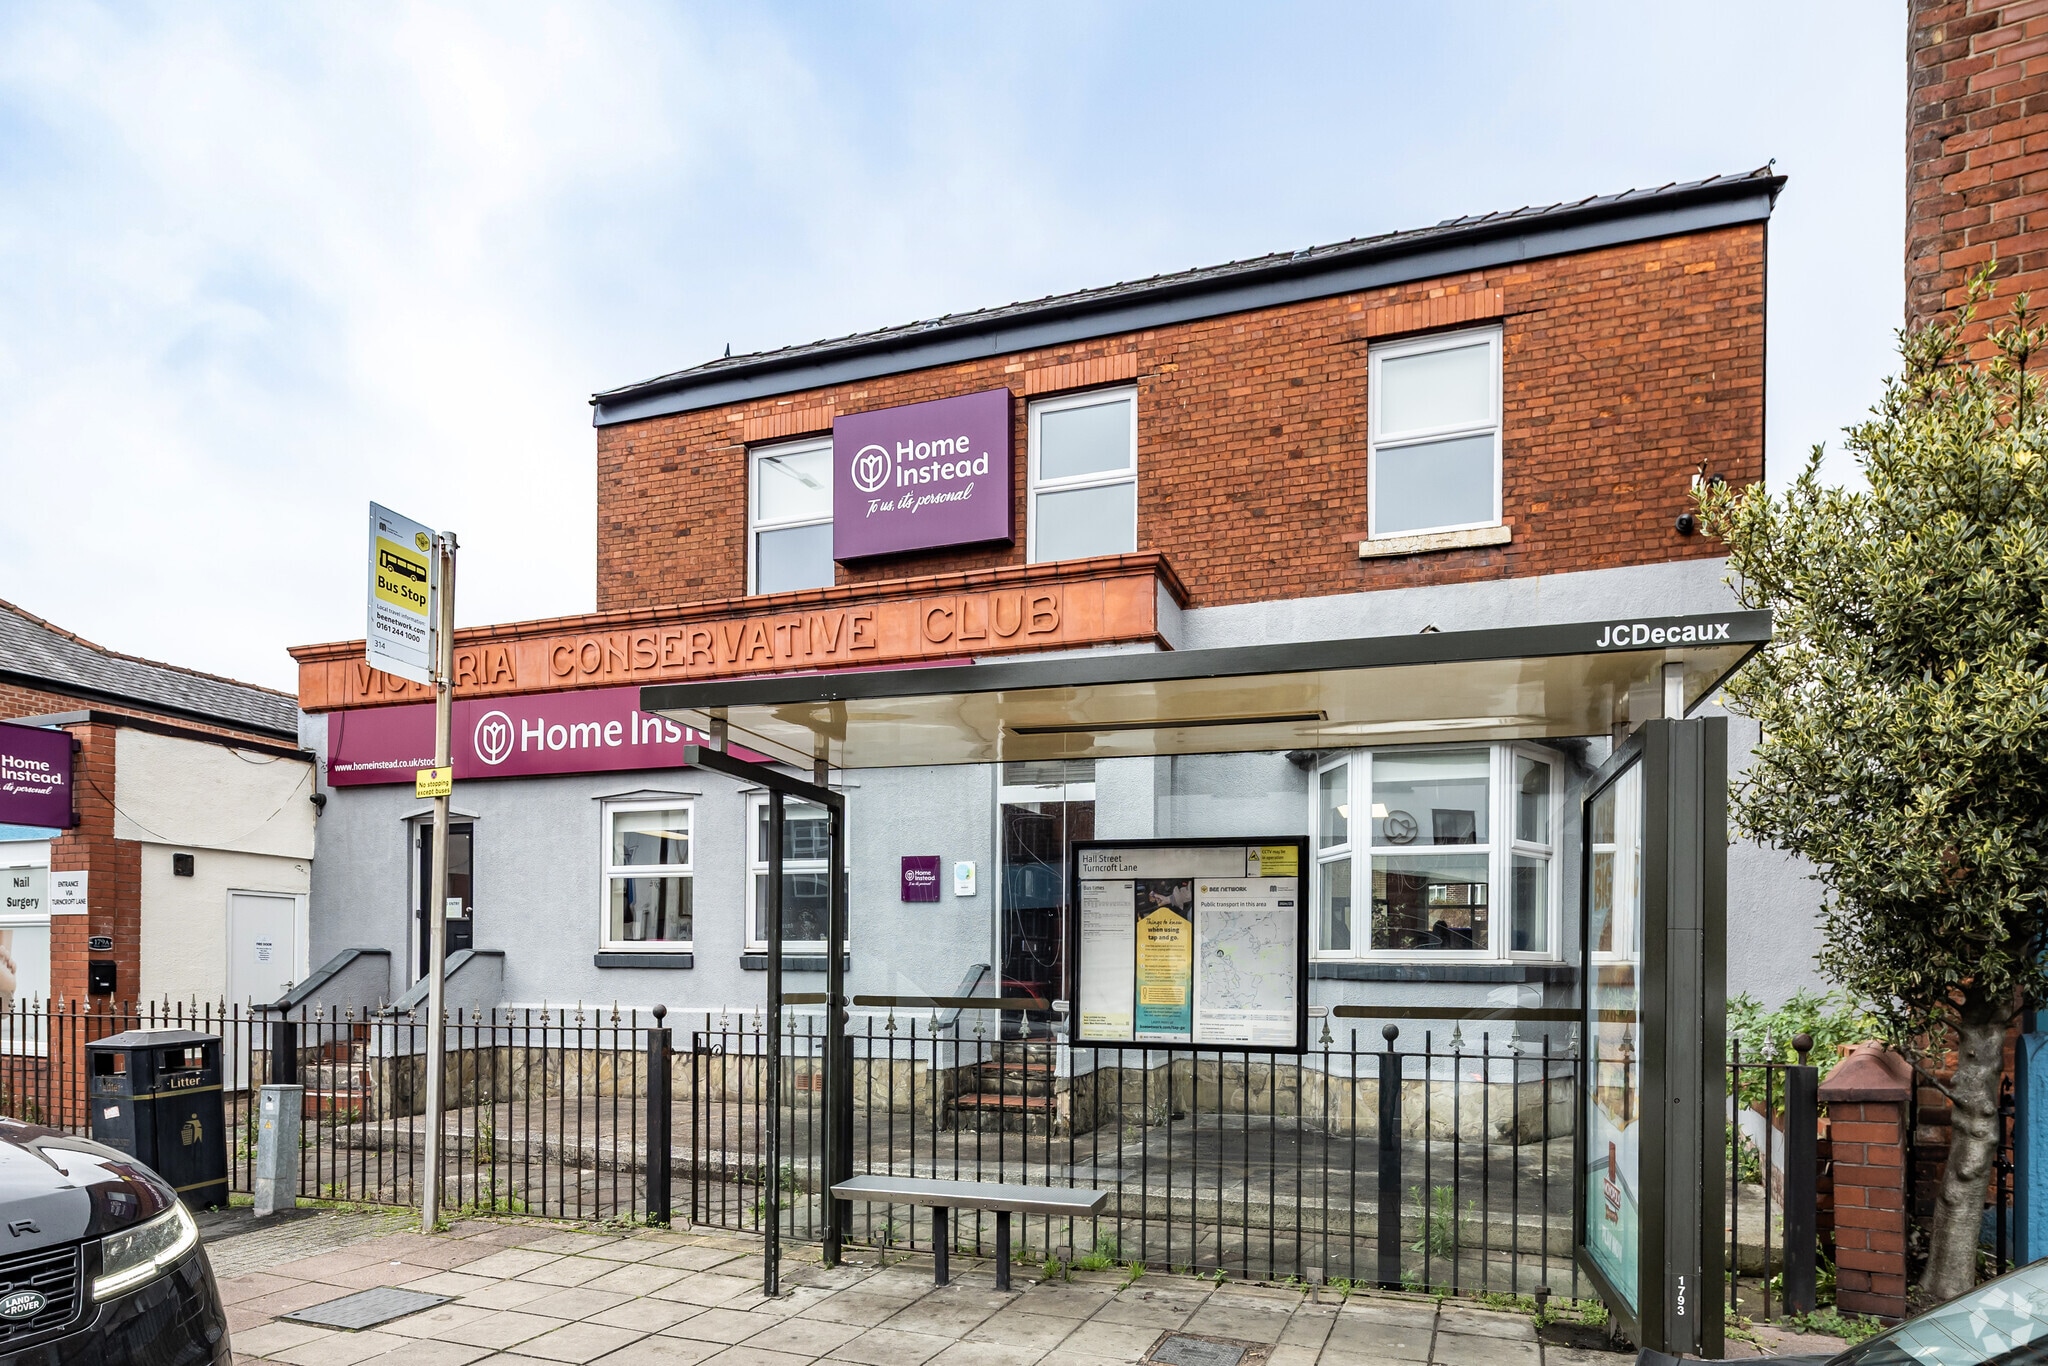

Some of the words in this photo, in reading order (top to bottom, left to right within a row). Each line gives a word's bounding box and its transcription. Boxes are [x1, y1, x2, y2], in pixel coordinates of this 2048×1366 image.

[896, 436, 970, 463] Home
[896, 452, 989, 487] Instead
[866, 499, 881, 518] To
[880, 500, 895, 511] us,
[912, 482, 974, 513] personal
[378, 575, 398, 594] Bus
[401, 585, 426, 607] Stop
[377, 604, 388, 612] Local
[389, 608, 400, 617] travel
[401, 614, 426, 626] information:
[377, 612, 426, 636] beenetwork.com
[377, 622, 391, 632] 0161
[392, 628, 404, 637] 244
[405, 632, 420, 642] 1000
[1596, 623, 1730, 648] JCDecaux
[357, 648, 514, 695] VICRIA
[551, 610, 876, 677] CONSERVATIVE
[922, 593, 1060, 643] CLUB
[374, 640, 386, 649] 314
[521, 718, 622, 752] Home
[2, 754, 50, 771] Home
[335, 757, 454, 771] www.homeinstead.co.uk/stoct
[2, 767, 64, 785] Instead.
[12, 786, 53, 795] personal
[1082, 854, 1097, 862] Hall
[1099, 854, 1122, 862] Street
[1083, 863, 1117, 872] Turncroft
[1120, 863, 1138, 872] Lane
[14, 876, 30, 888] Nail
[6, 896, 40, 910] Surgery
[170, 1077, 200, 1088] Litter
[8, 1218, 40, 1237] R
[6, 1296, 30, 1308] LAND
[1677, 1276, 1686, 1316] 1793
[10, 1301, 40, 1315] ROVER
